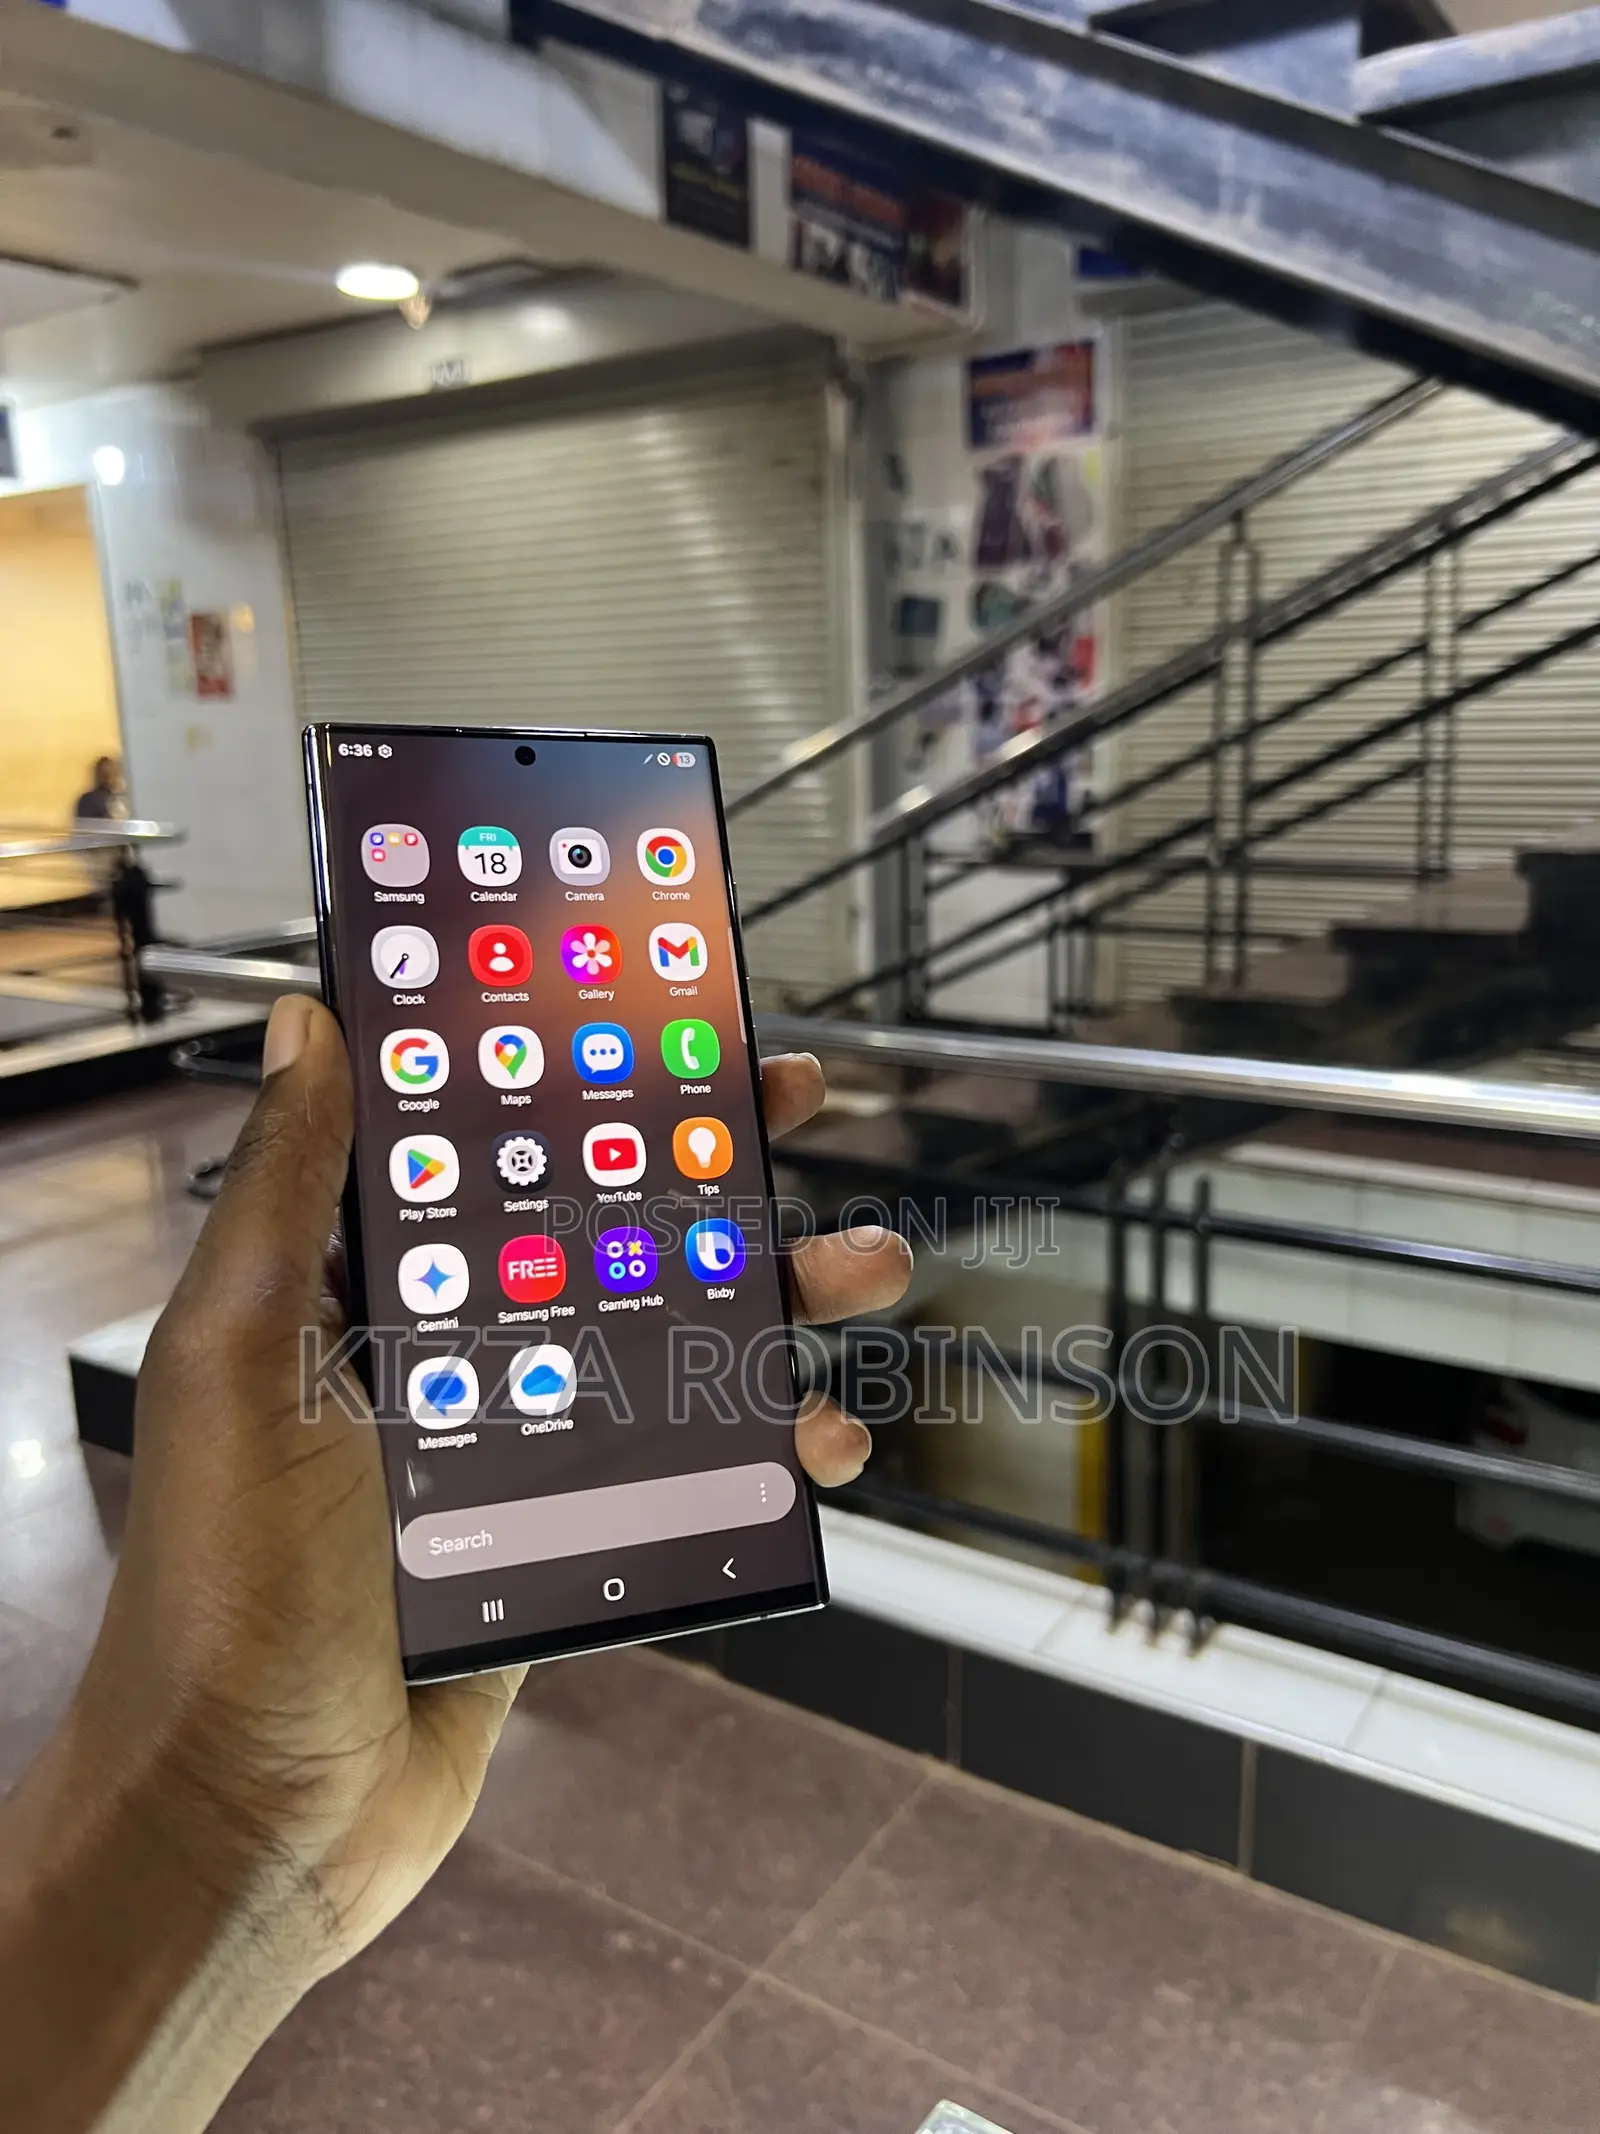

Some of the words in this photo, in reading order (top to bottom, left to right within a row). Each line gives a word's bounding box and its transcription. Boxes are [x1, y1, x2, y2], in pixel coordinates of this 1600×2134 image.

[339, 743, 373, 759] 6:36
[480, 833, 496, 842] FRI
[474, 852, 507, 876] 18
[374, 891, 425, 903] Samsung
[471, 891, 517, 902] Calendar
[566, 891, 604, 902] Camera
[652, 891, 691, 901] Chrome
[482, 992, 529, 1003] Contacts
[579, 989, 615, 1001] Gallery
[670, 986, 698, 997] Gmail
[393, 994, 425, 1005] Clock
[583, 1088, 634, 1101] Messages
[680, 1083, 711, 1095] Phone
[398, 1098, 440, 1112] Google
[501, 1094, 531, 1107] Maps
[697, 1183, 719, 1196] Tips
[597, 1190, 642, 1203] YouTube
[503, 1198, 548, 1213] Settings
[400, 1208, 425, 1222] Play
[427, 1206, 457, 1220] Store
[508, 1257, 558, 1281] FREE
[706, 1287, 735, 1302] Bixby
[599, 1298, 639, 1313] Gaming
[641, 1294, 663, 1308] Hub
[498, 1308, 548, 1324] Samsung
[551, 1304, 575, 1318] Free
[417, 1318, 458, 1333] Gemini
[521, 1418, 574, 1435] OneDrive
[419, 1432, 477, 1451] Messages
[428, 1530, 493, 1555] Search
